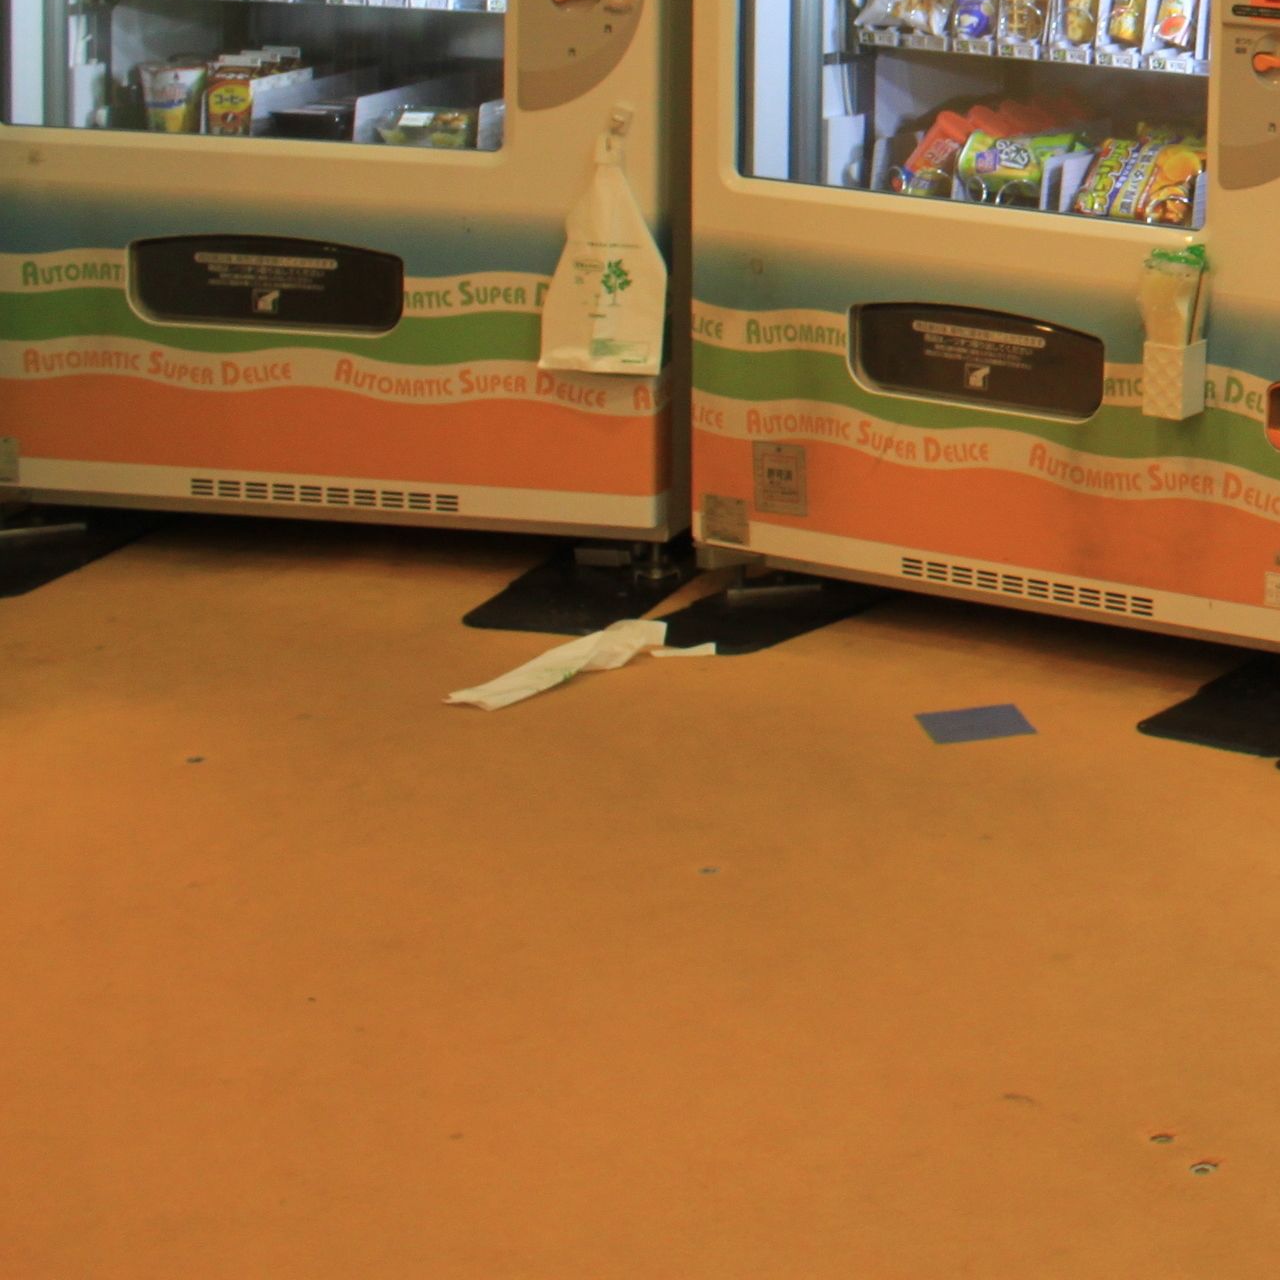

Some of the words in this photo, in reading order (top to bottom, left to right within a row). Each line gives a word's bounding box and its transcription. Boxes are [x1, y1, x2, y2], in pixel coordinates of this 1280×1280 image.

[22, 261, 122, 286] AUTOMAT
[459, 282, 526, 307] SUPER
[23, 348, 141, 372] AUTOMATIC
[147, 352, 213, 387] SUPER
[221, 360, 292, 386] DELICE
[334, 359, 453, 397] AUTOMATIC
[459, 369, 528, 396] SUPER
[536, 370, 607, 408] DELICE
[1224, 375, 1264, 414] DEL
[745, 409, 851, 441] AUTOMATIC
[856, 421, 917, 460] SUPER
[923, 440, 990, 464] DELICE
[1029, 443, 1142, 491] AUTOMATIC
[1149, 463, 1213, 494] SUPER
